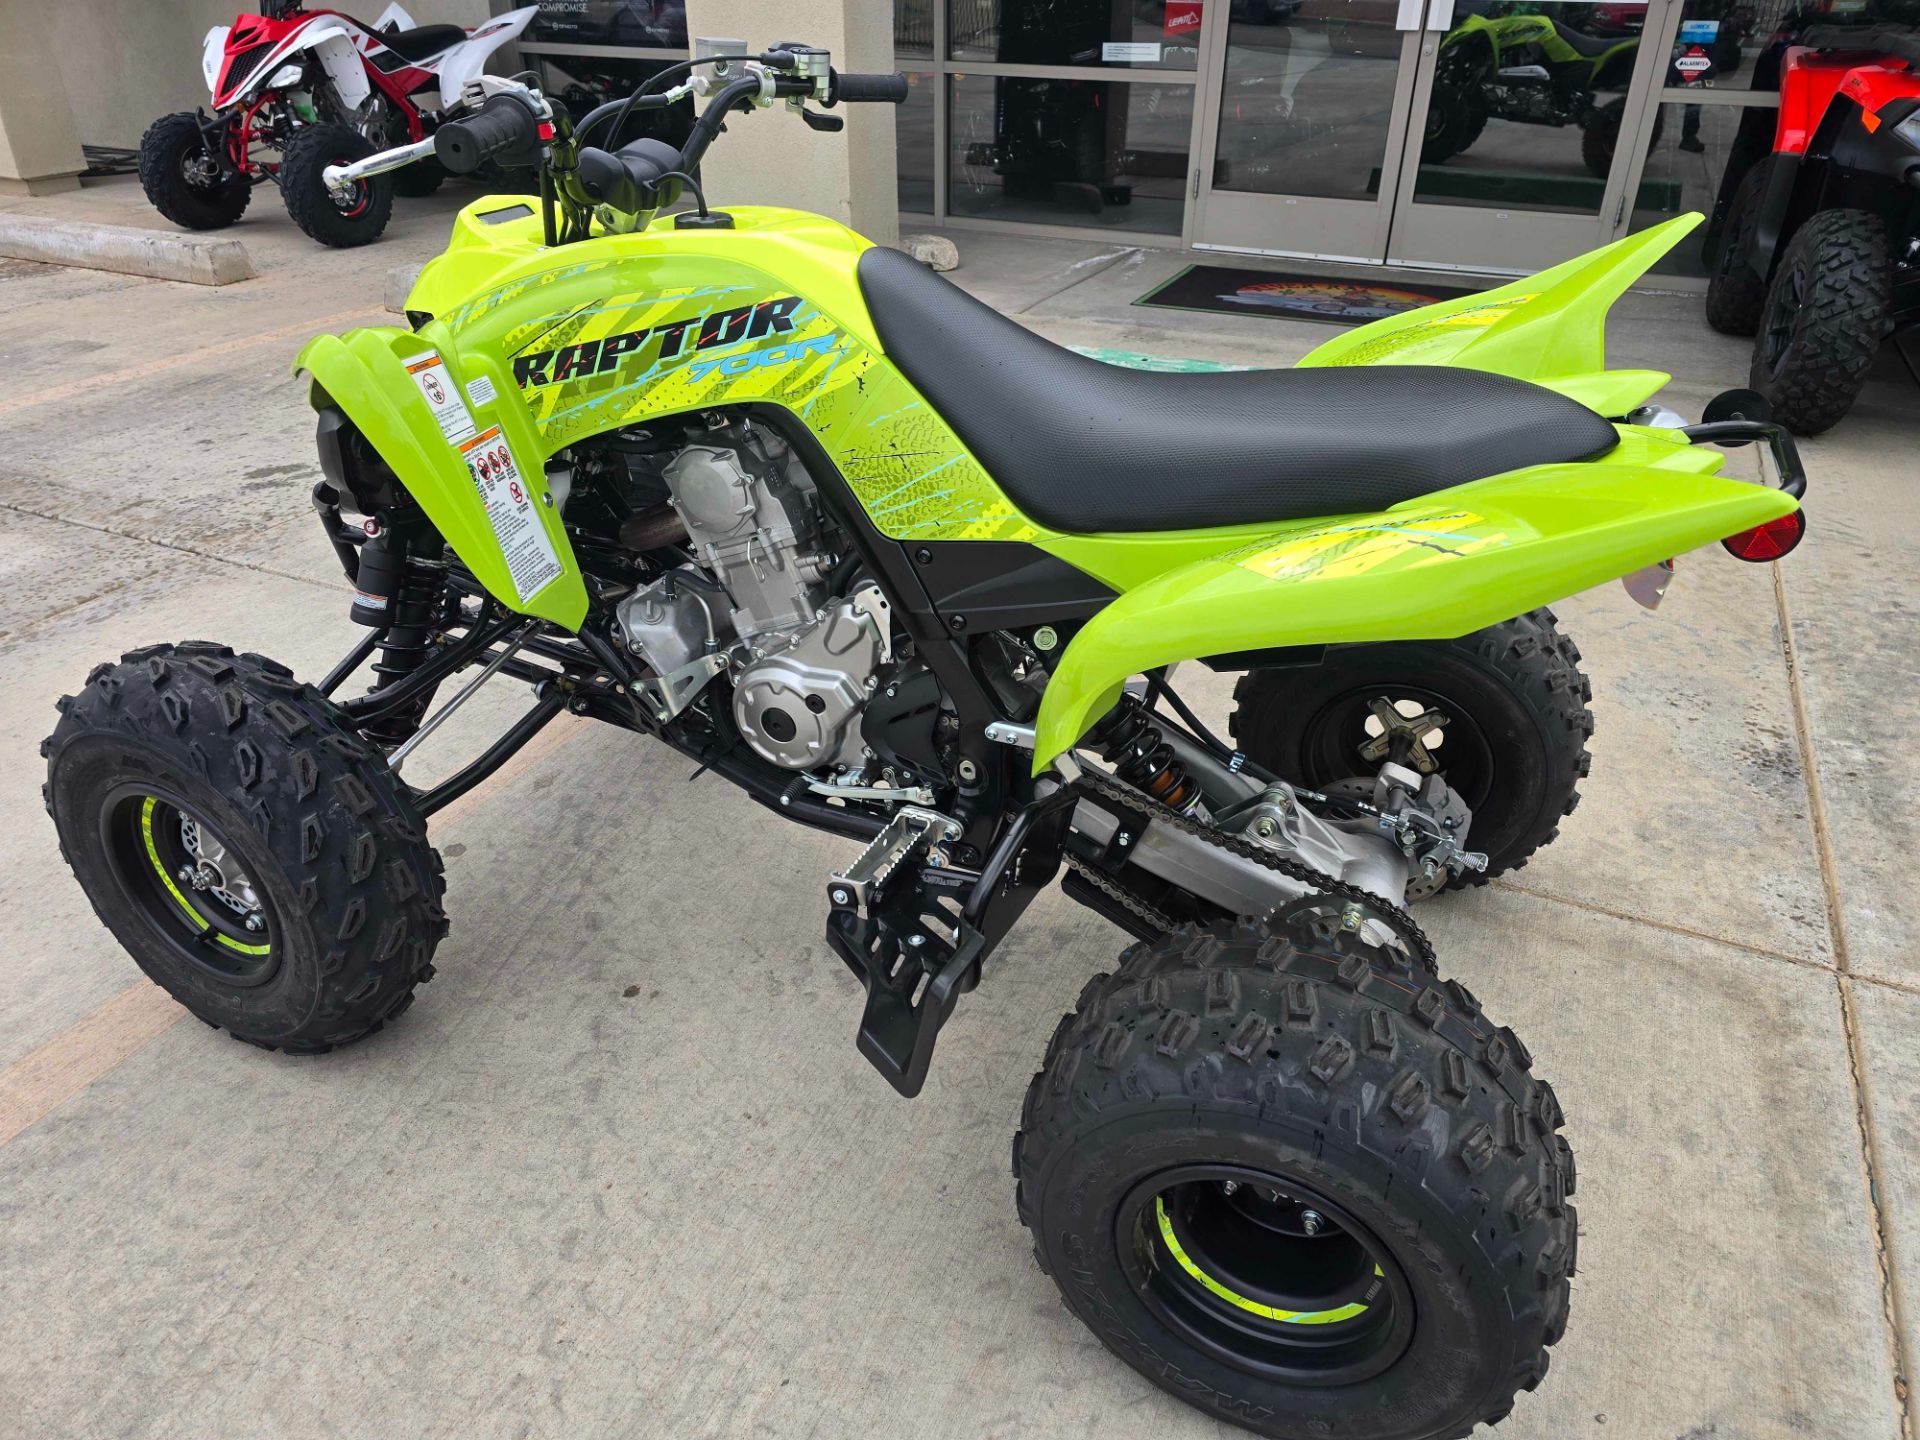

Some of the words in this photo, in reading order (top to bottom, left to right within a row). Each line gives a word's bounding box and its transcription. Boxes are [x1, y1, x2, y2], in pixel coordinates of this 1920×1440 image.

[512, 296, 807, 391] RAPTOR
[685, 333, 843, 385] 700R
[433, 391, 443, 401] 16
